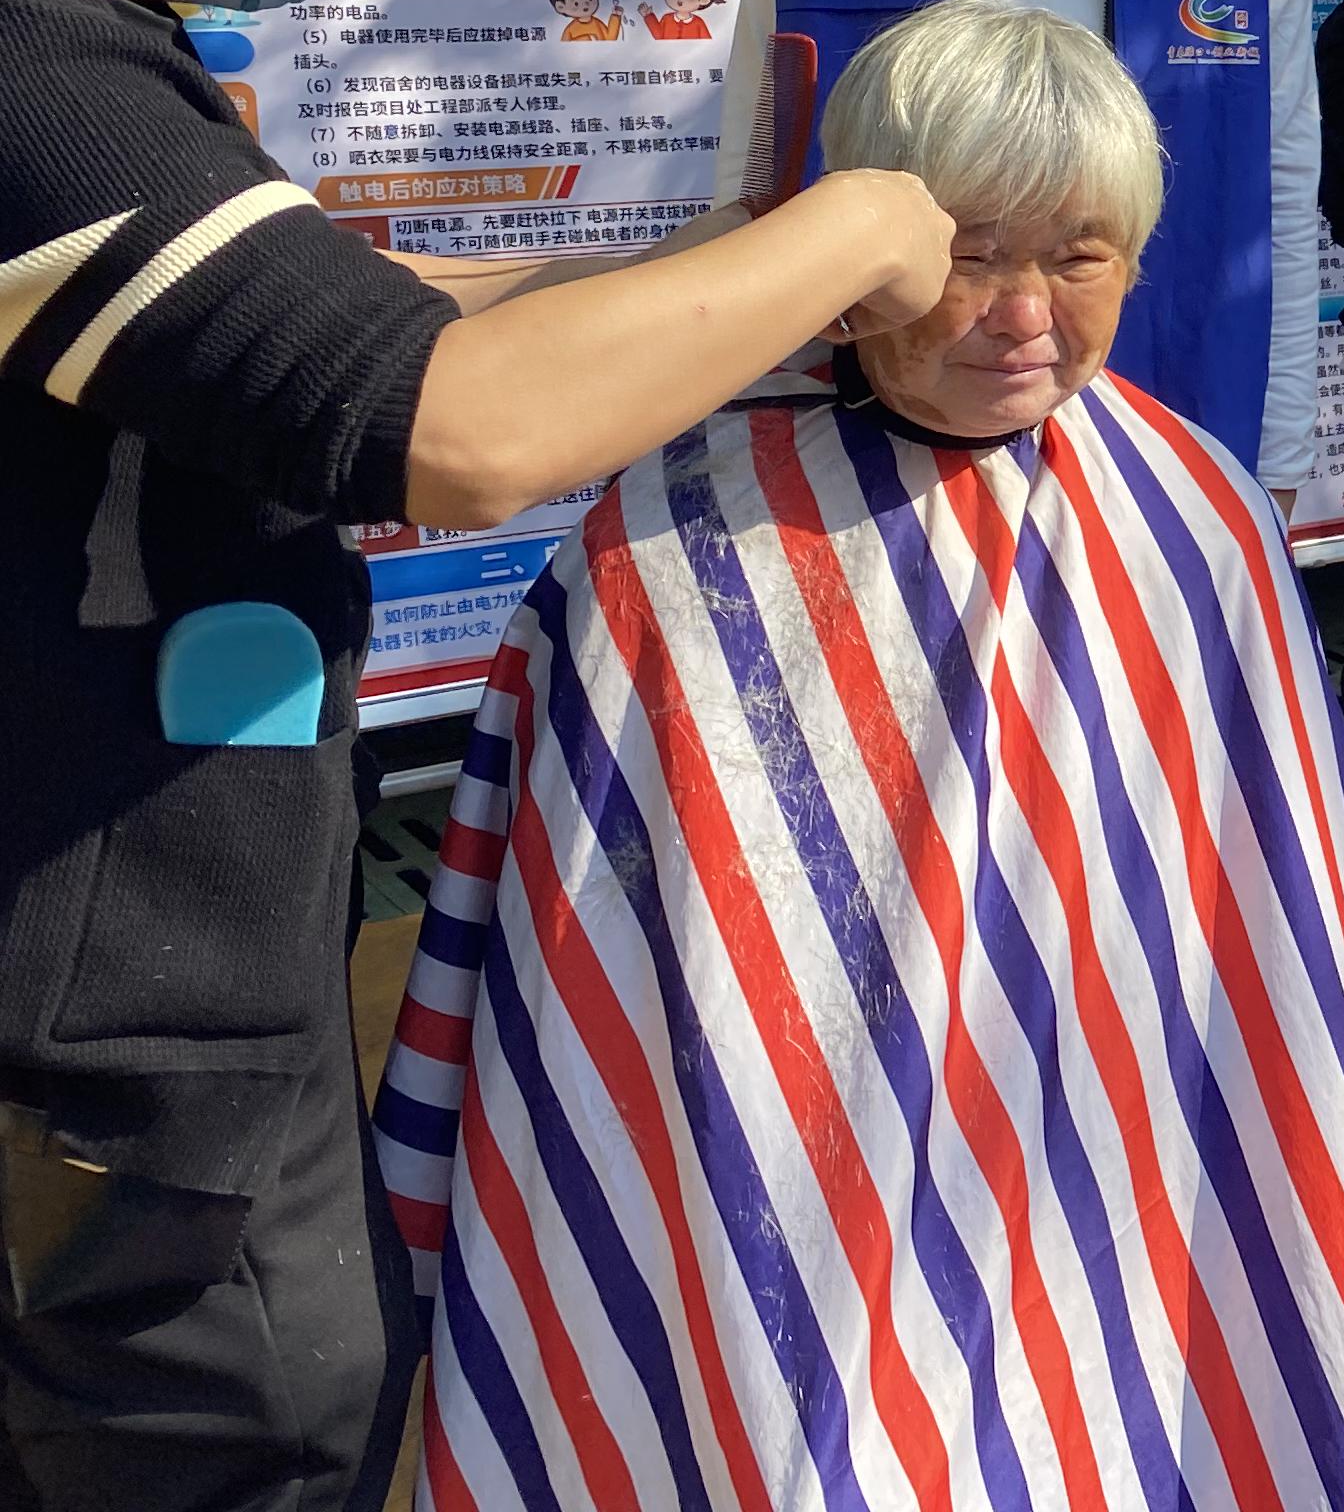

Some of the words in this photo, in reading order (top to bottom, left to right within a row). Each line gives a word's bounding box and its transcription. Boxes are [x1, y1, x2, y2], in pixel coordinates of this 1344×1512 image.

[295, 54, 338, 70] 插头。
[298, 96, 566, 119] 及时报告项目处工程部派专人修理。
[339, 175, 526, 202] 触电后的应对策略
